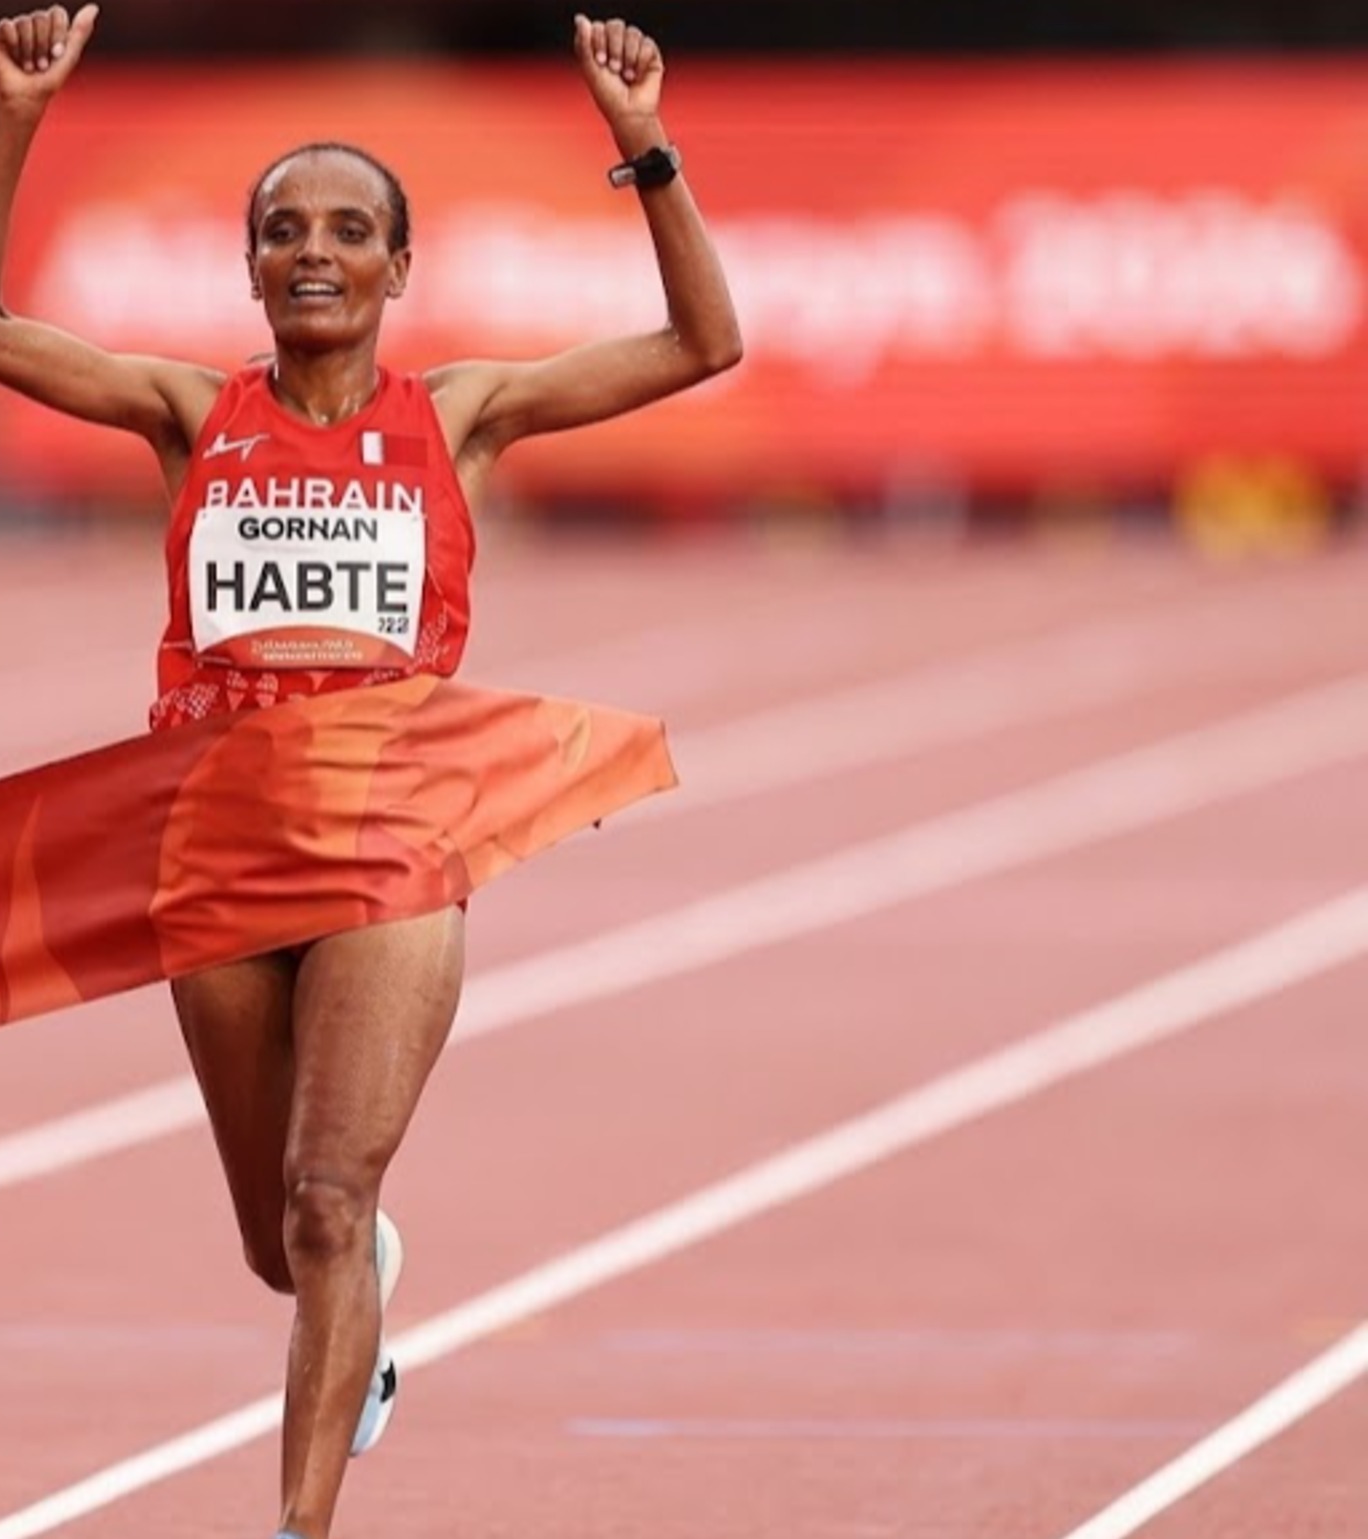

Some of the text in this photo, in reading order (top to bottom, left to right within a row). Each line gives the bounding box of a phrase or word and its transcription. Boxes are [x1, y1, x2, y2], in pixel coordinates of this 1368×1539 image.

[206, 477, 422, 514] BAHRAIN
[238, 516, 378, 542] GORNAN
[205, 560, 409, 614] HABTE
